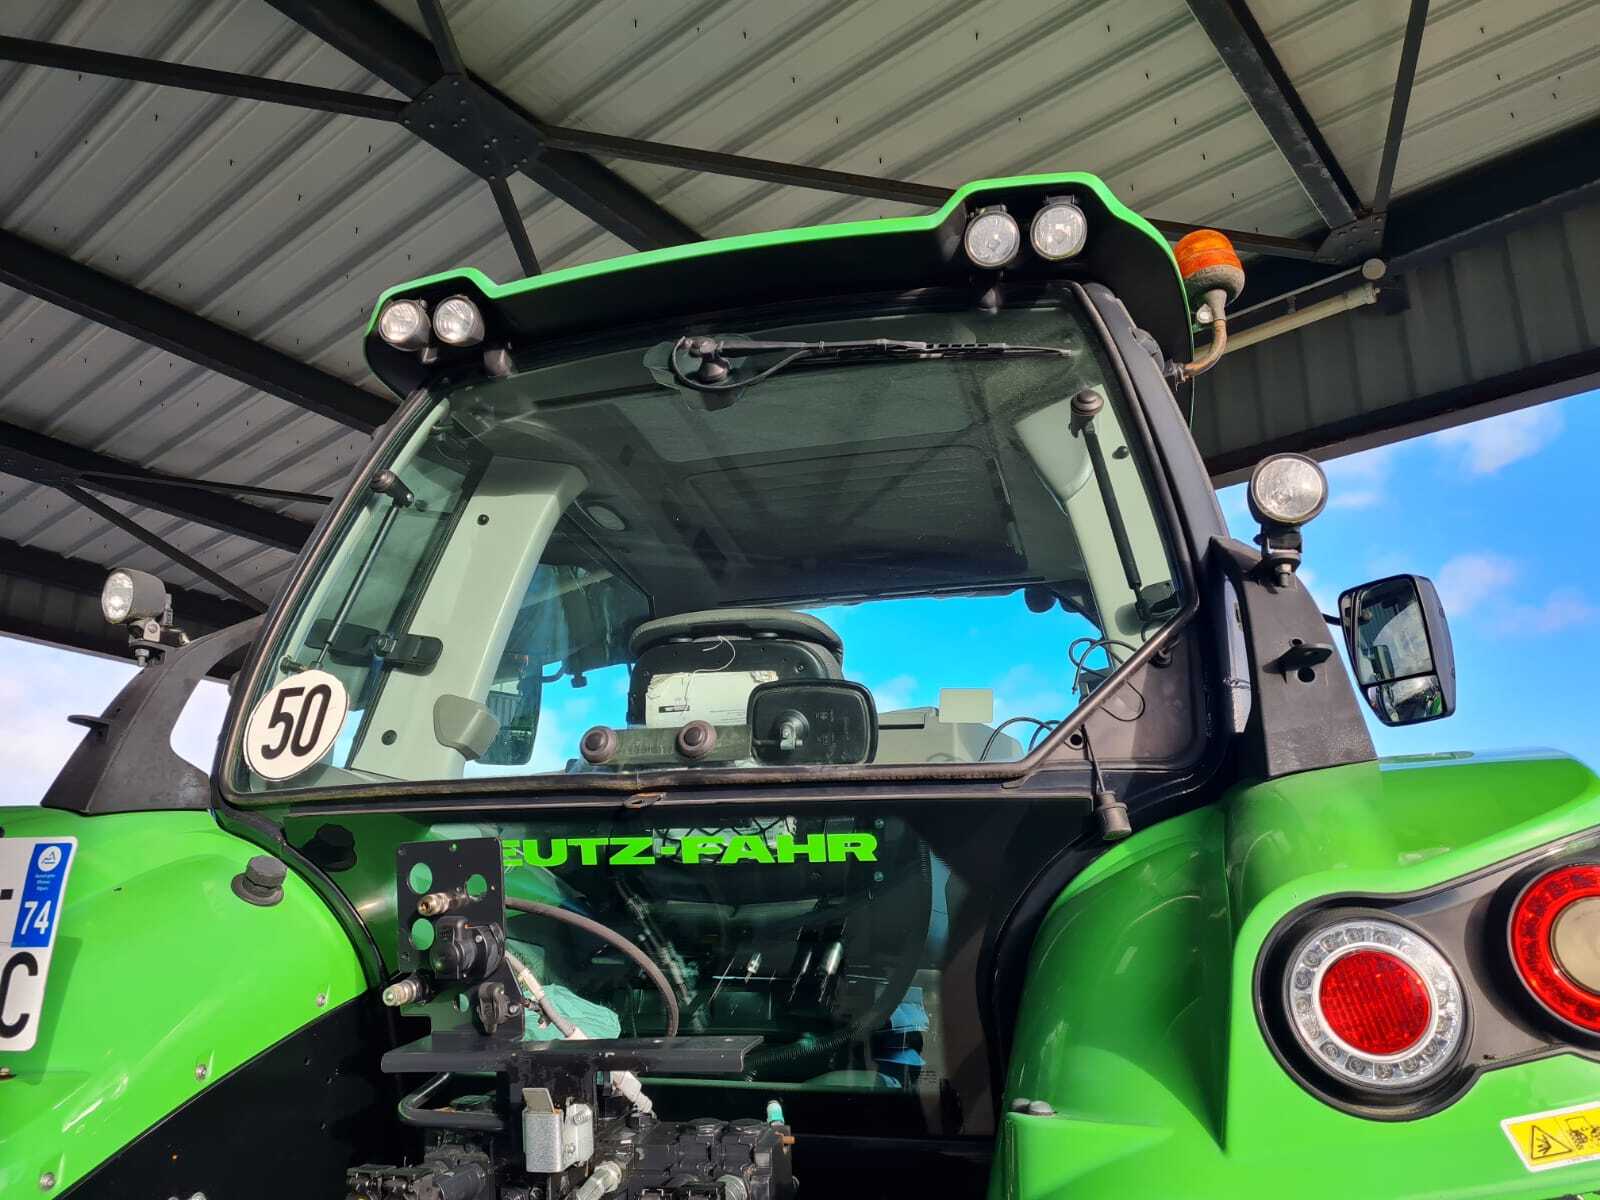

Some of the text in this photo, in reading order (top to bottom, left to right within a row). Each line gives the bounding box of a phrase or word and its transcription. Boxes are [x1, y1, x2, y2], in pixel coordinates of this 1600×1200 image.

[261, 684, 331, 760] 50
[502, 833, 878, 866] EUTZ-FAHR
[21, 900, 51, 934] 74
